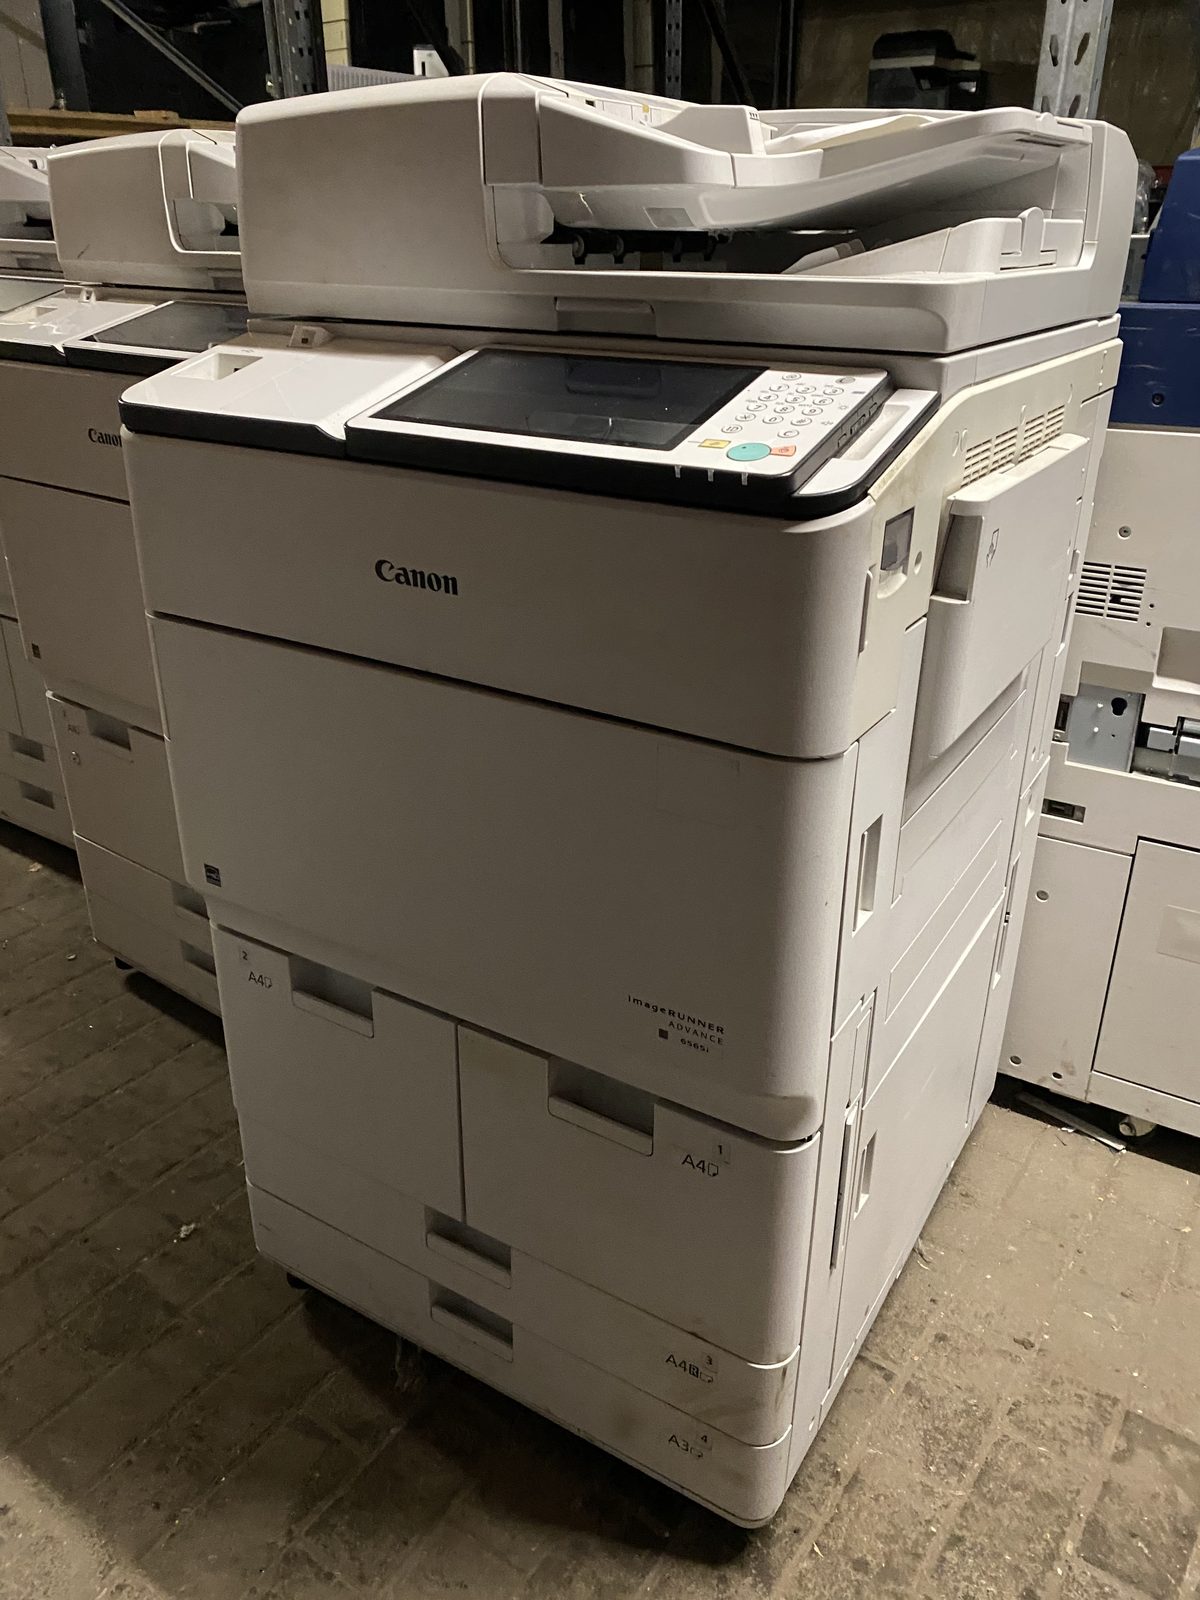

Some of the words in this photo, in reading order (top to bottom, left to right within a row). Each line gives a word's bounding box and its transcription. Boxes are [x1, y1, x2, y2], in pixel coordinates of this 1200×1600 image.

[375, 559, 458, 596] Canon
[242, 950, 248, 961] 2
[248, 970, 265, 987] A4
[628, 995, 725, 1035] imageRUNNER
[668, 1020, 724, 1046] ADVANCE
[680, 1038, 709, 1053] 6565i
[718, 1144, 723, 1155] 1
[681, 1154, 706, 1174] A4
[706, 1355, 713, 1366] 3
[668, 1434, 689, 1452] A3
[700, 1435, 708, 1444] 4
